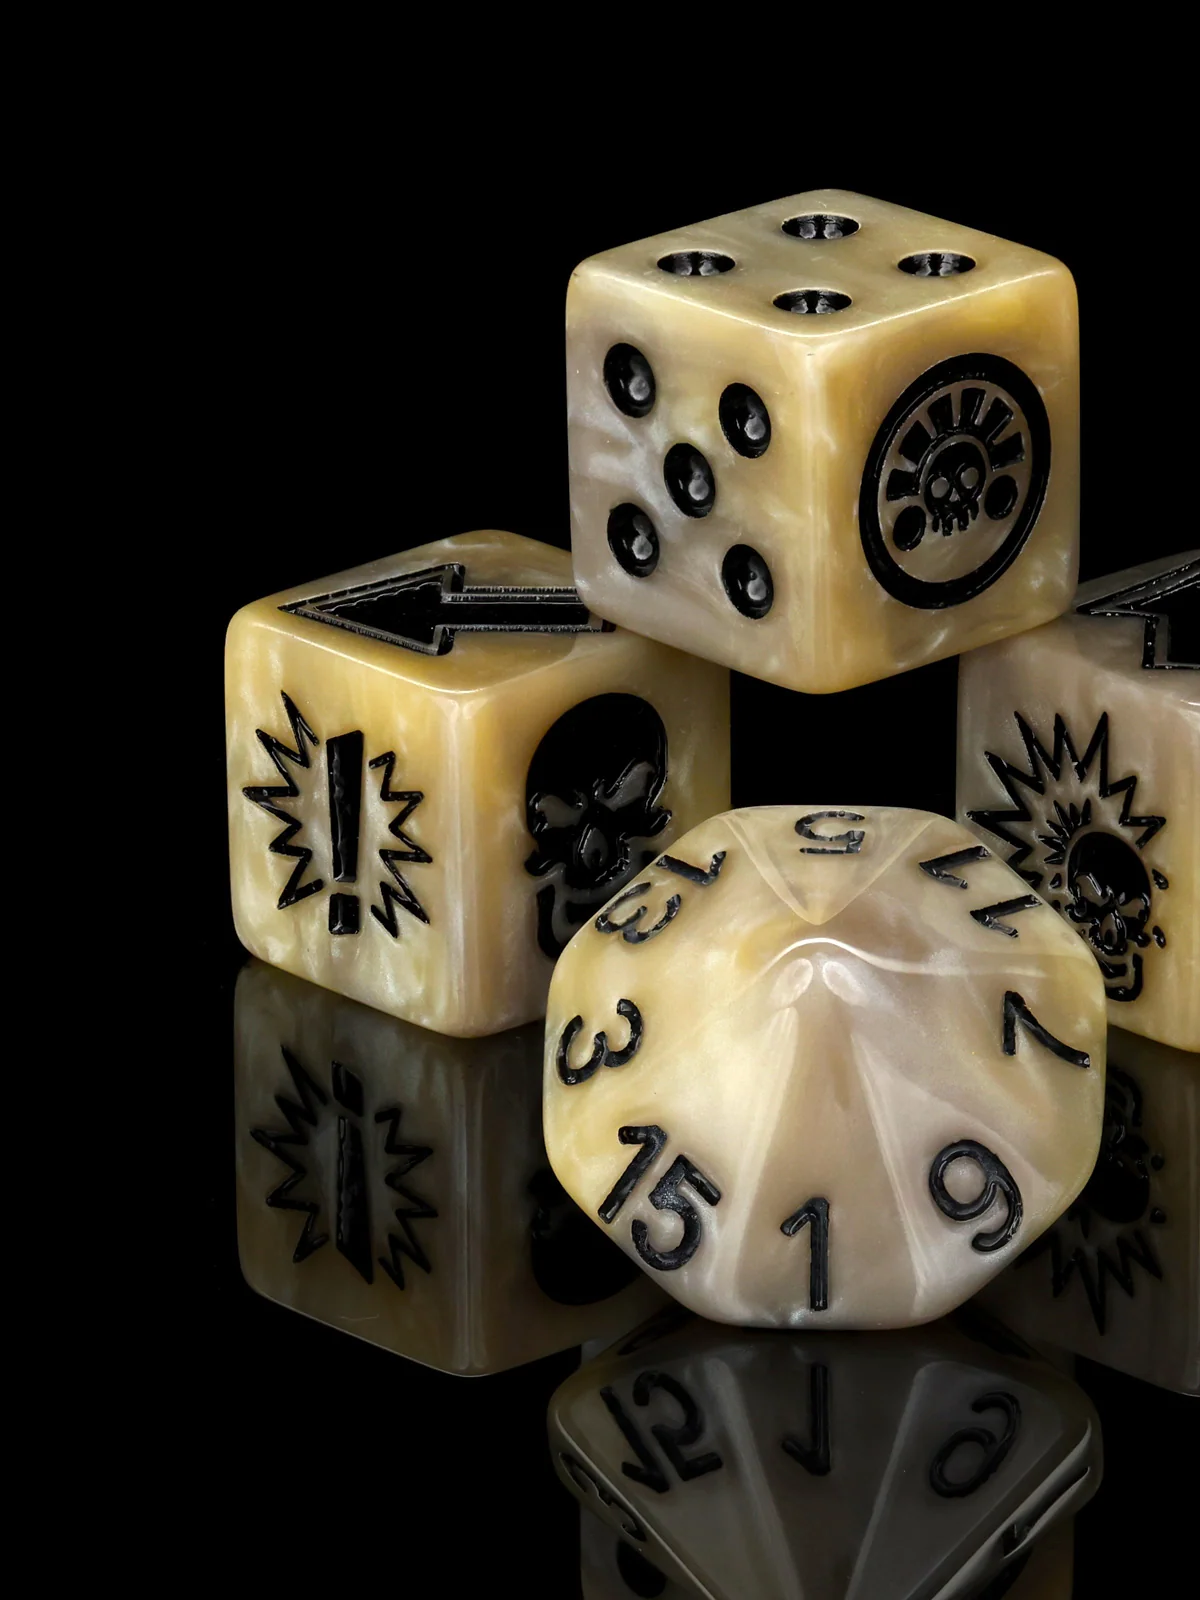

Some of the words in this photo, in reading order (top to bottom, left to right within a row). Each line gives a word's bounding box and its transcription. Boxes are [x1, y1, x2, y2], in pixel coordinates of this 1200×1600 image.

[794, 810, 866, 855] 5
[595, 850, 727, 944] 13
[557, 998, 645, 1085] 3
[1003, 991, 1091, 1069] 7
[598, 1124, 722, 1272] 15
[928, 1139, 1022, 1253] 9
[780, 1197, 830, 1312] 1
